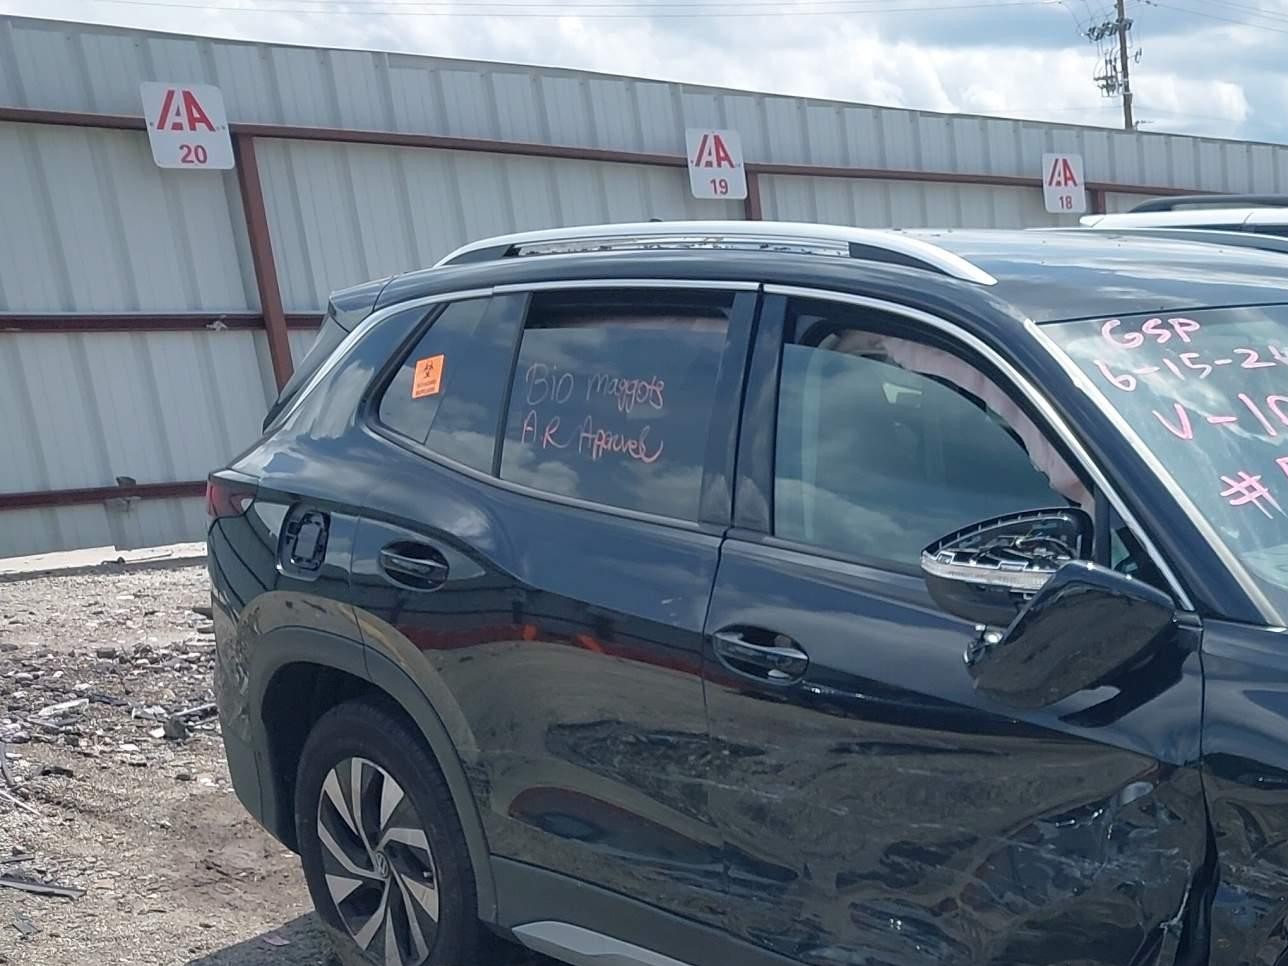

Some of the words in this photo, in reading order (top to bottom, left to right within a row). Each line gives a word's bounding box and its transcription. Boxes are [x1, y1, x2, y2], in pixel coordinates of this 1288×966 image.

[179, 144, 207, 164] 20
[709, 178, 729, 196] 19
[1059, 195, 1073, 210] 18
[1100, 317, 1201, 350] GSP
